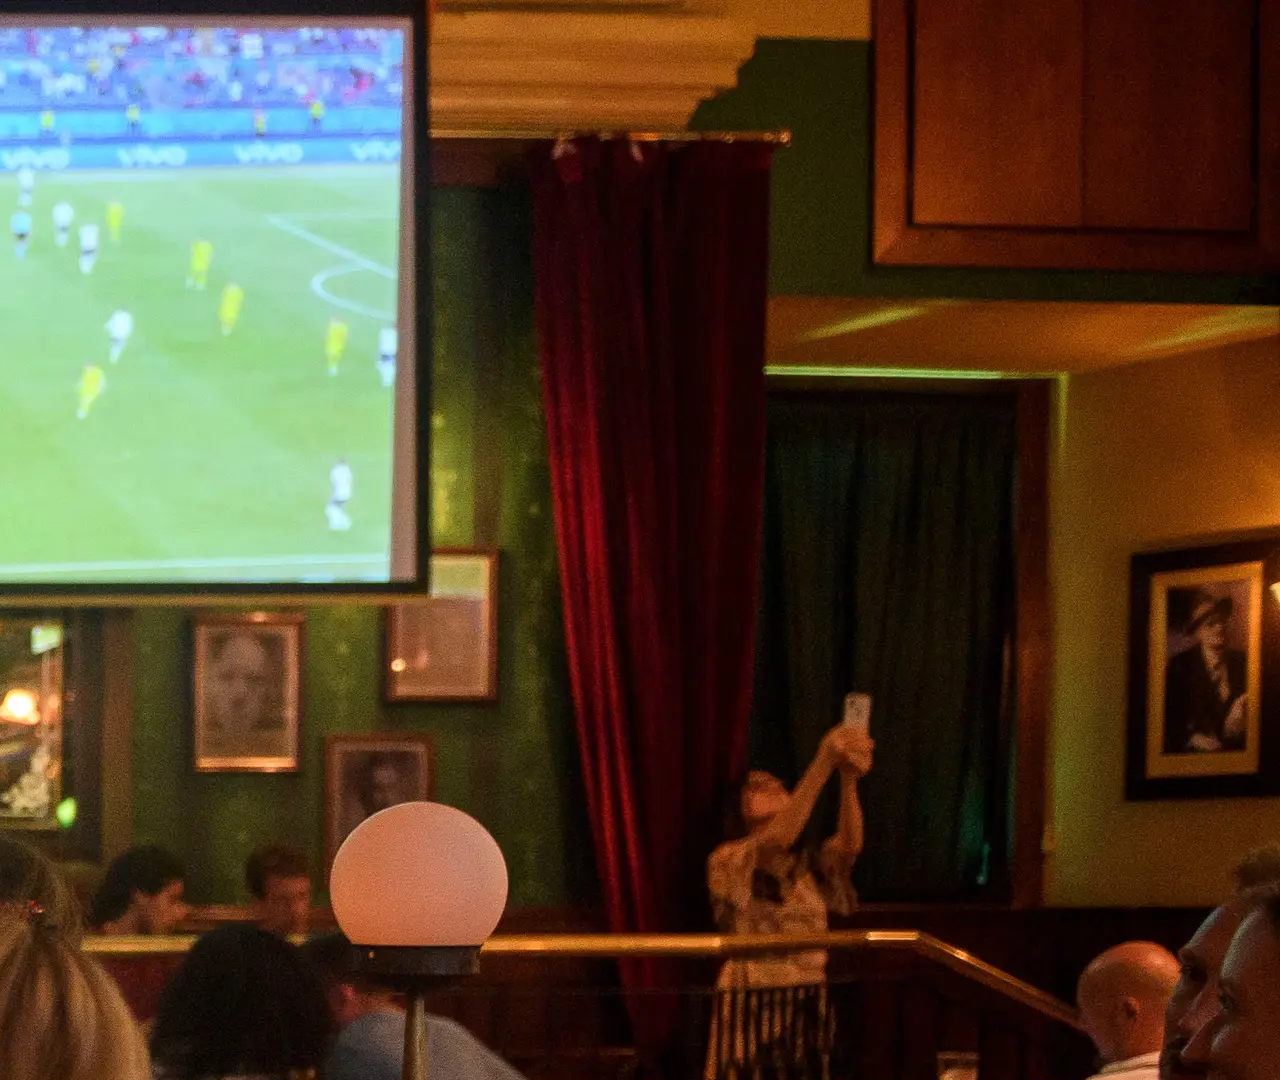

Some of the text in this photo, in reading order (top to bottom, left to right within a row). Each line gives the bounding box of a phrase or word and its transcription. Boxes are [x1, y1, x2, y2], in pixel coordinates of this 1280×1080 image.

[2, 145, 71, 169] vivo
[117, 145, 188, 166] vivo
[234, 141, 304, 163] vivo
[349, 138, 400, 160] viv
